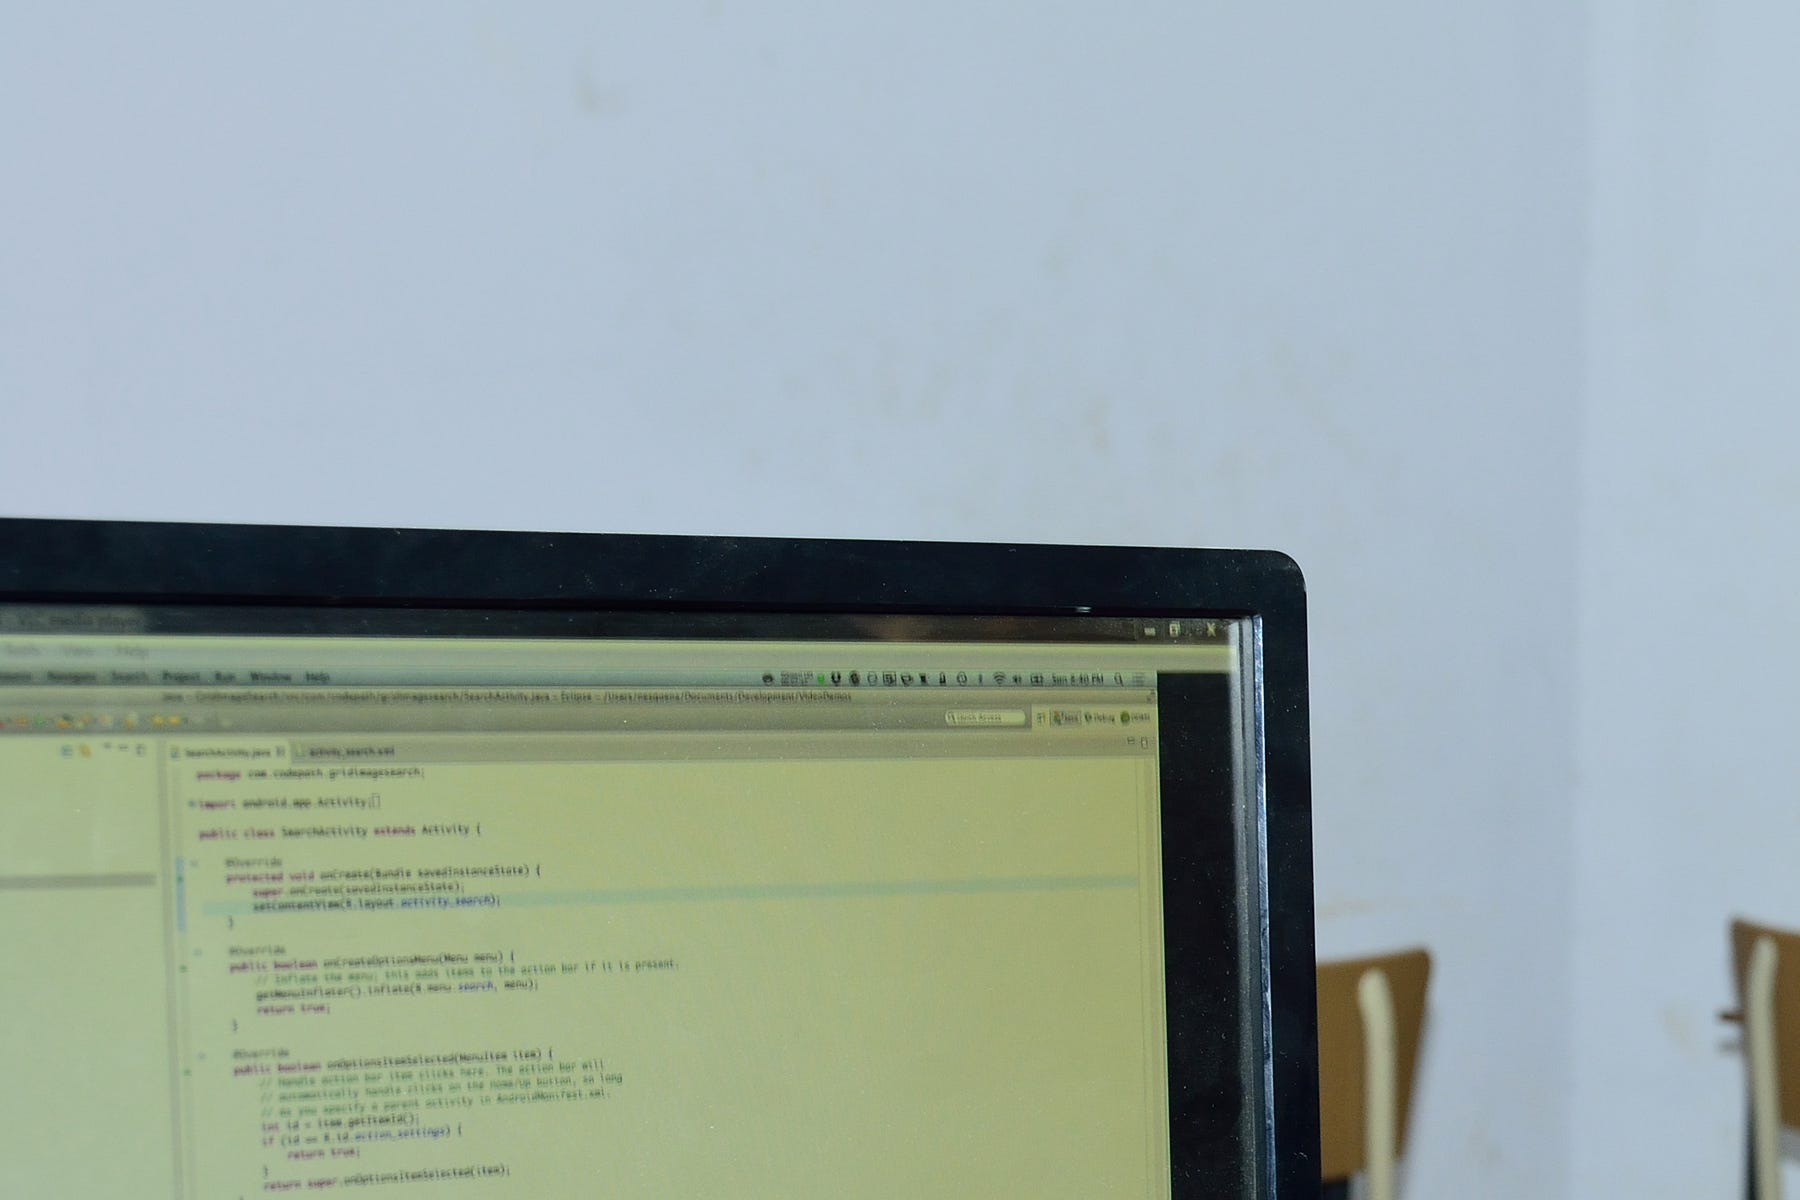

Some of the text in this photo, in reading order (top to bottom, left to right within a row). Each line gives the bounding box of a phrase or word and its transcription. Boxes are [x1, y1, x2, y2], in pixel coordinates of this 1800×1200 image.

[162, 671, 200, 683] Project
[215, 671, 236, 681] Run
[250, 671, 292, 681] Window
[306, 671, 330, 683] Help
[197, 770, 241, 783] package
[199, 800, 236, 811] import
[199, 829, 237, 842] public
[244, 828, 275, 839] class
[282, 825, 368, 840] SearchActivity
[374, 825, 416, 837] extends
[422, 823, 470, 837] Activity
[225, 857, 283, 868] @Override
[226, 871, 284, 884] protected
[290, 870, 315, 882] void
[320, 867, 412, 881] onCreate(Bundle
[229, 945, 286, 957] @Override
[230, 961, 267, 974] public
[274, 959, 318, 970] boolean
[474, 949, 504, 963] menu)
[276, 973, 318, 985] Inflate
[325, 972, 343, 982] the
[385, 967, 409, 979] this
[415, 967, 439, 979] adds
[446, 966, 474, 977] items
[481, 965, 492, 976] to
[498, 964, 515, 975] the
[521, 963, 556, 975] action
[561, 961, 578, 973] bar
[585, 961, 597, 972] if
[602, 960, 613, 971] it
[619, 960, 631, 971] is
[635, 958, 680, 973] present.
[505, 980, 539, 992] menu);
[257, 1002, 331, 1015] return true;
[233, 1048, 289, 1059] @Override
[234, 1064, 272, 1077] public
[278, 1062, 322, 1073] boolean
[513, 1047, 542, 1061] item)
[278, 1076, 316, 1087] Handle
[321, 1073, 359, 1085] action
[364, 1071, 382, 1082] bar
[390, 1069, 413, 1081] item
[419, 1066, 455, 1080] clicks
[496, 1063, 513, 1075] The
[519, 1062, 554, 1074] action
[559, 1060, 576, 1072] bar
[582, 1058, 604, 1071] will
[279, 1087, 360, 1102] automatically
[366, 1084, 402, 1096] handle
[407, 1082, 443, 1095] clicks
[448, 1081, 461, 1092] on
[467, 1079, 484, 1090] the
[536, 1075, 577, 1089] button,
[583, 1074, 594, 1085] so
[601, 1071, 623, 1085] long
[280, 1107, 292, 1117] as
[299, 1106, 318, 1118] you
[323, 1101, 365, 1116] specify
[384, 1099, 419, 1112] parent
[425, 1096, 472, 1109] activity
[480, 1095, 491, 1105] in
[262, 1122, 280, 1132] int
[287, 1118, 300, 1130] id
[263, 1136, 274, 1147] if
[281, 1134, 300, 1148] (id
[288, 1146, 361, 1161] return true;
[264, 1181, 301, 1192] return
